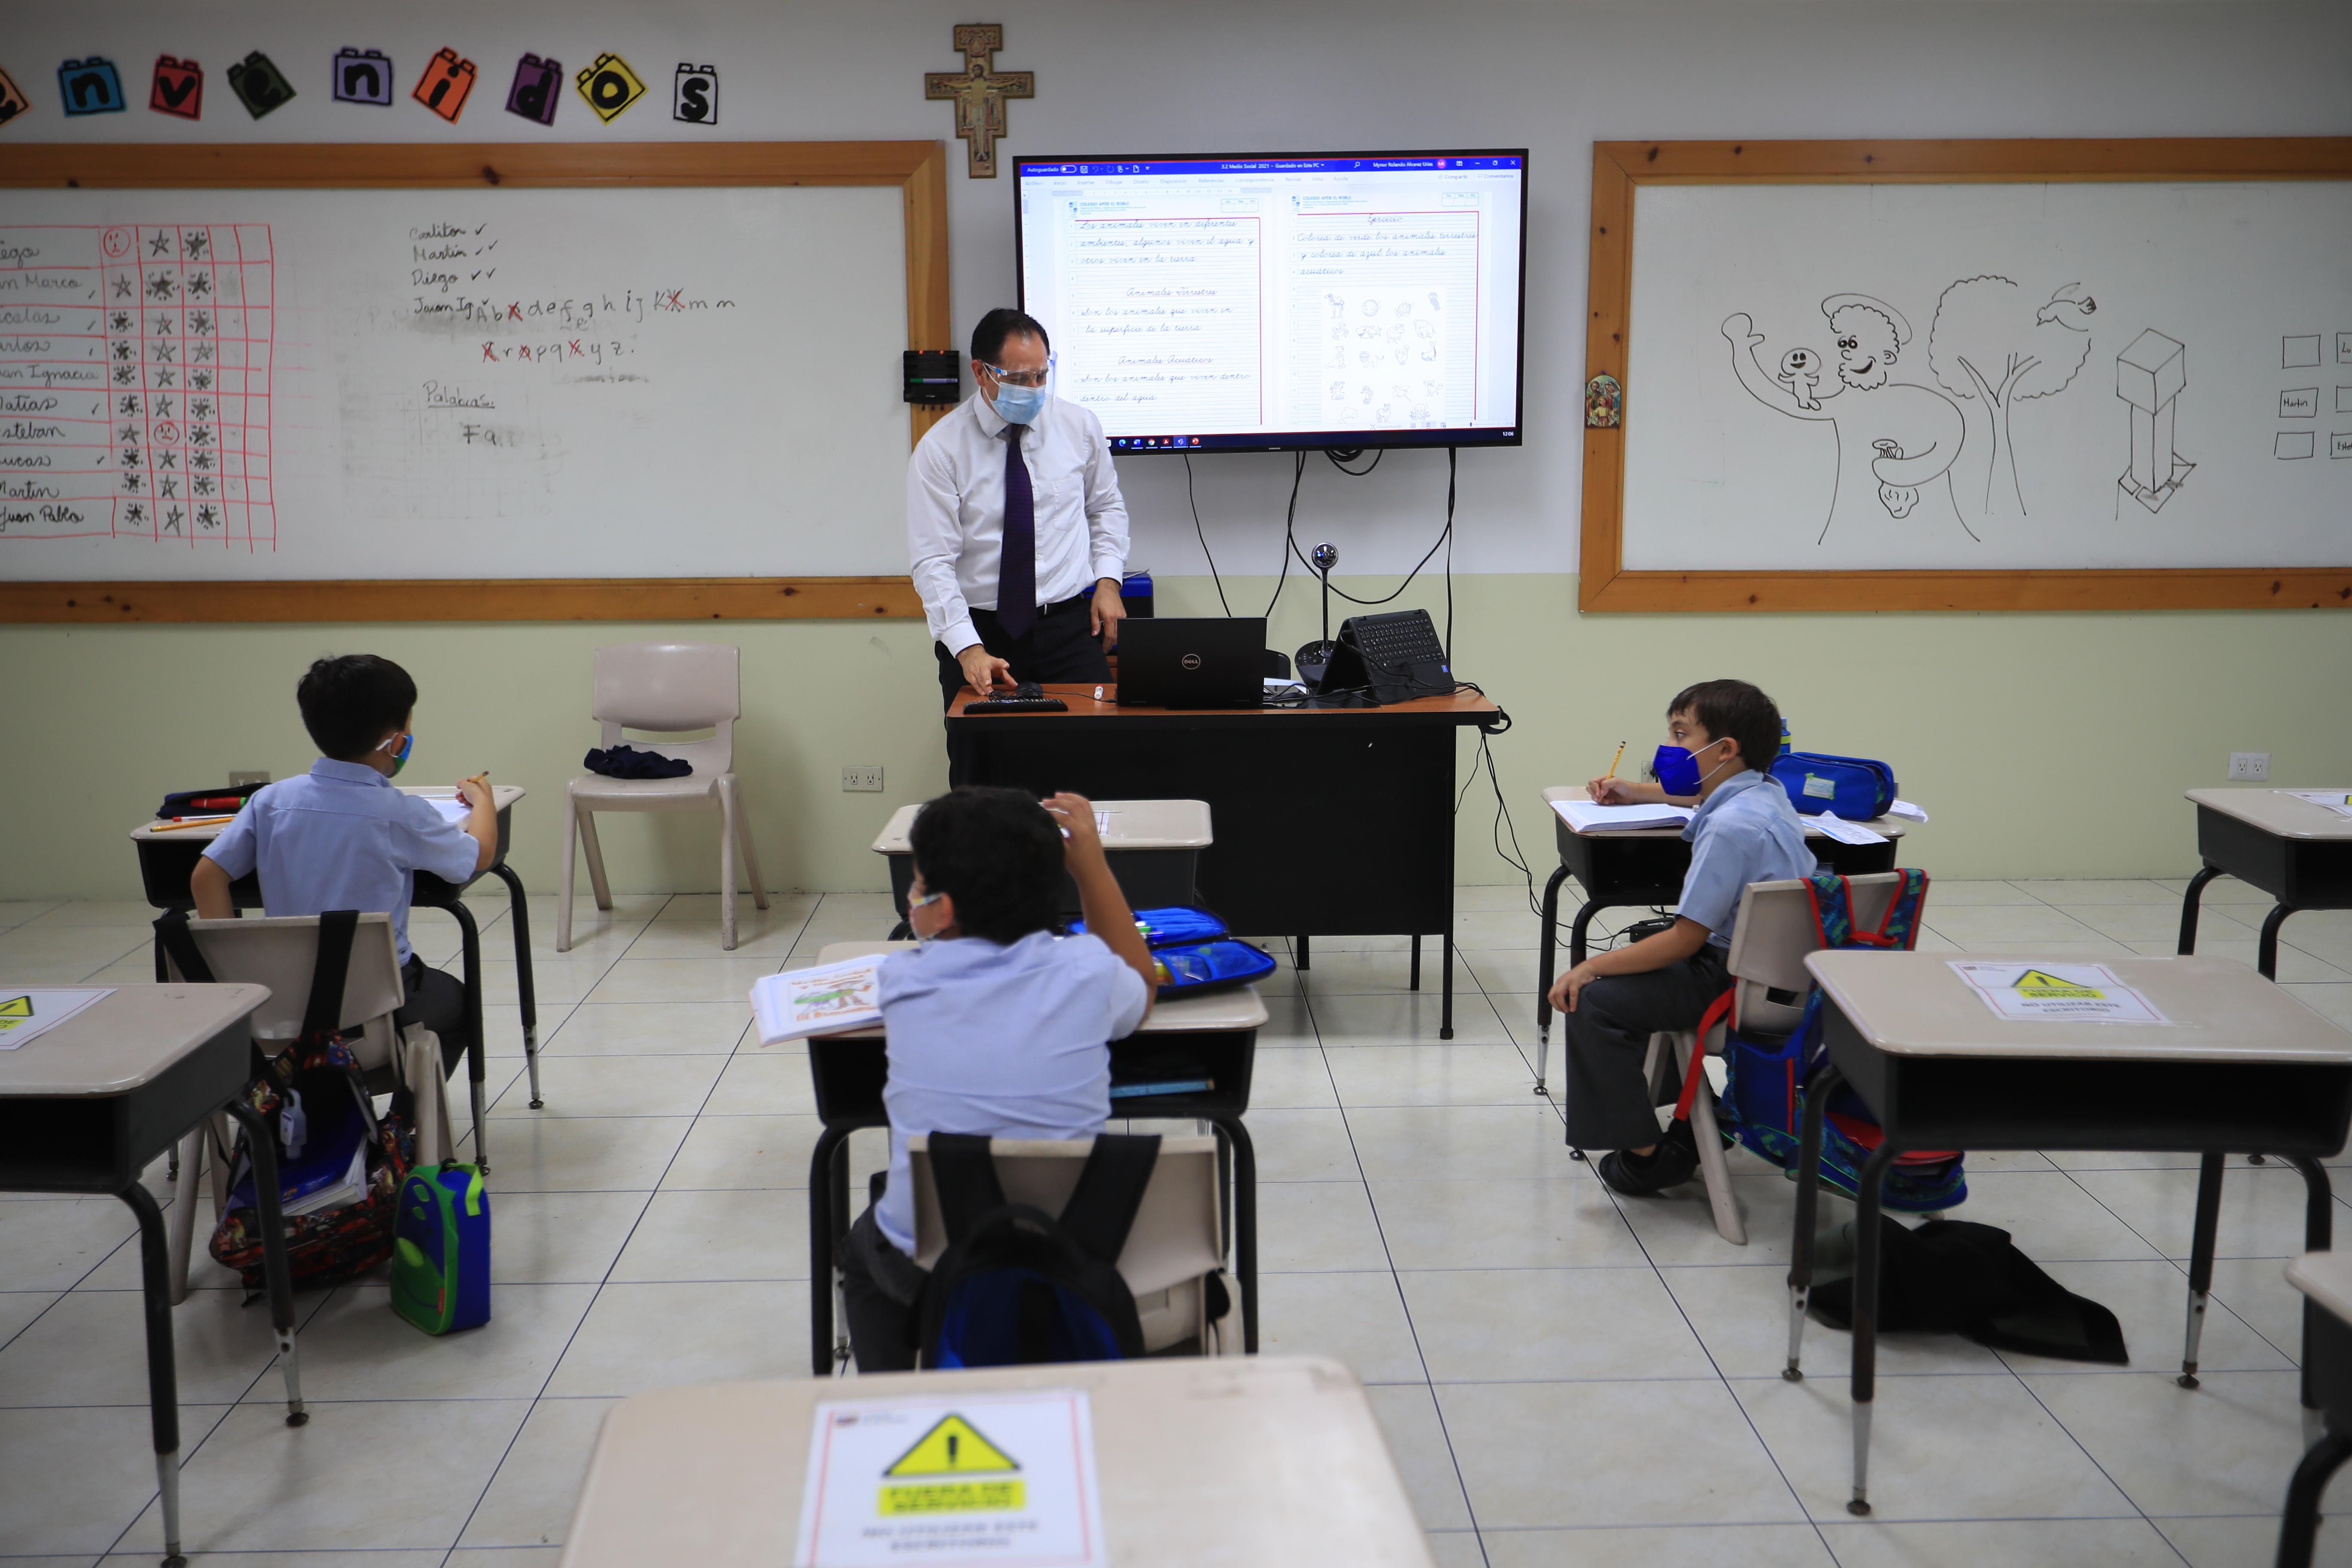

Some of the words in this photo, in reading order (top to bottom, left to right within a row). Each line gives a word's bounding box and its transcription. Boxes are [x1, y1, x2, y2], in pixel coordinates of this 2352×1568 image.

[1080, 220, 1096, 230] Los
[1099, 219, 1144, 229] animales
[1195, 218, 1237, 230] diferentes
[1367, 213, 1404, 225] Ejercicio
[1297, 233, 1332, 241] Colorea
[1375, 231, 1389, 240] los
[1392, 230, 1437, 239] animales
[1133, 237, 1172, 248] algunos
[1207, 236, 1215, 244] el
[1219, 238, 1244, 247] agua
[1247, 239, 1255, 247] y
[1155, 254, 1167, 263] la
[1300, 253, 1308, 261] y
[1311, 249, 1344, 257] colorea
[1360, 248, 1383, 260] azul
[1385, 248, 1400, 256] los
[1402, 247, 1446, 256] animales
[411, 268, 458, 293] Diego
[1127, 287, 1173, 296] Animales
[1176, 286, 1218, 296] Terrestres
[414, 296, 453, 314] Juan
[528, 299, 543, 316] d
[546, 302, 556, 314] e
[603, 294, 616, 311] h
[1081, 307, 1103, 316] Son
[1105, 306, 1120, 315] los
[1122, 306, 1167, 315] animales
[1170, 308, 1187, 317] que
[1085, 324, 1098, 333] la
[1099, 324, 1144, 336] superficie
[1160, 323, 1172, 331] la
[1118, 355, 1164, 364] Animales
[1167, 355, 1214, 364] Acuáticos
[1080, 374, 1103, 383] Son
[1105, 373, 1120, 382] los
[1121, 372, 1167, 382] animales
[1169, 375, 1186, 384] que
[1115, 392, 1129, 401] del
[2283, 398, 2308, 407] Martin
[0, 421, 65, 440] steban
[40, 505, 84, 524] Pablo
